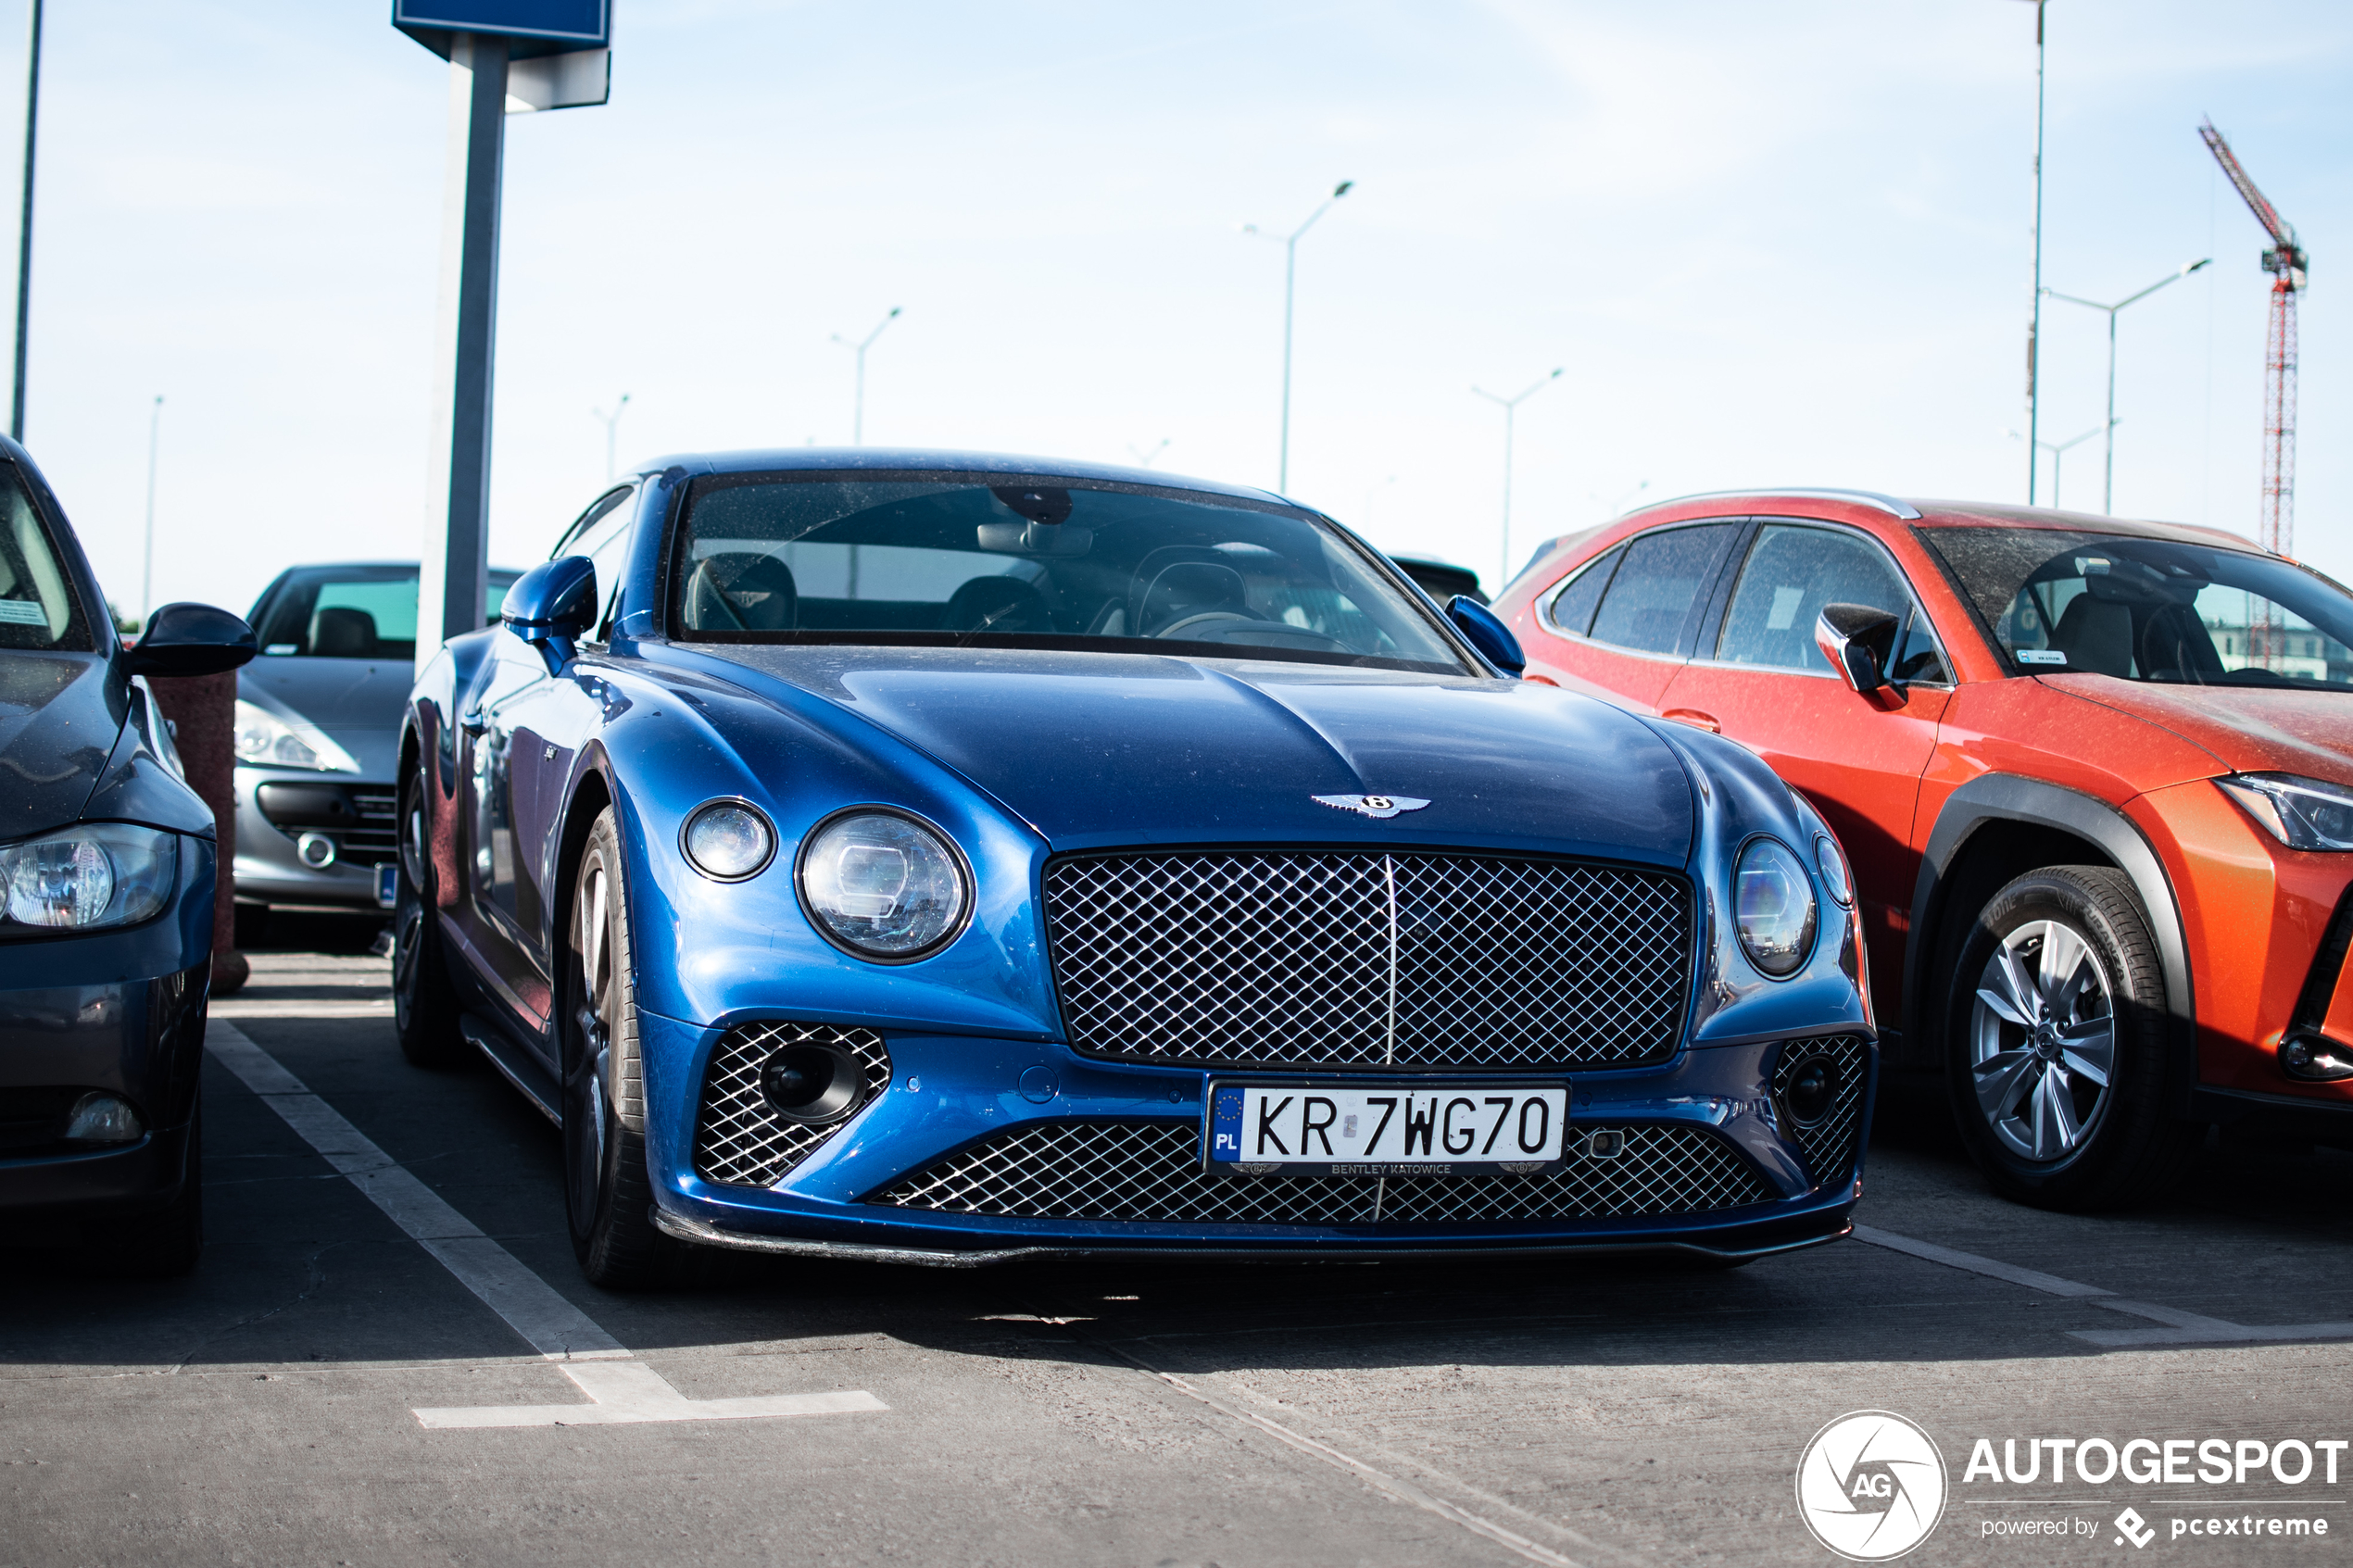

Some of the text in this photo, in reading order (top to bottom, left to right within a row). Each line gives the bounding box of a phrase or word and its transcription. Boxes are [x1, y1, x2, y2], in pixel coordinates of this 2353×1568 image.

[1256, 1096, 1550, 1156] KR 7WG70
[1215, 1134, 1238, 1150] PL
[1331, 1164, 1452, 1174] BENTLEY KATOWICE
